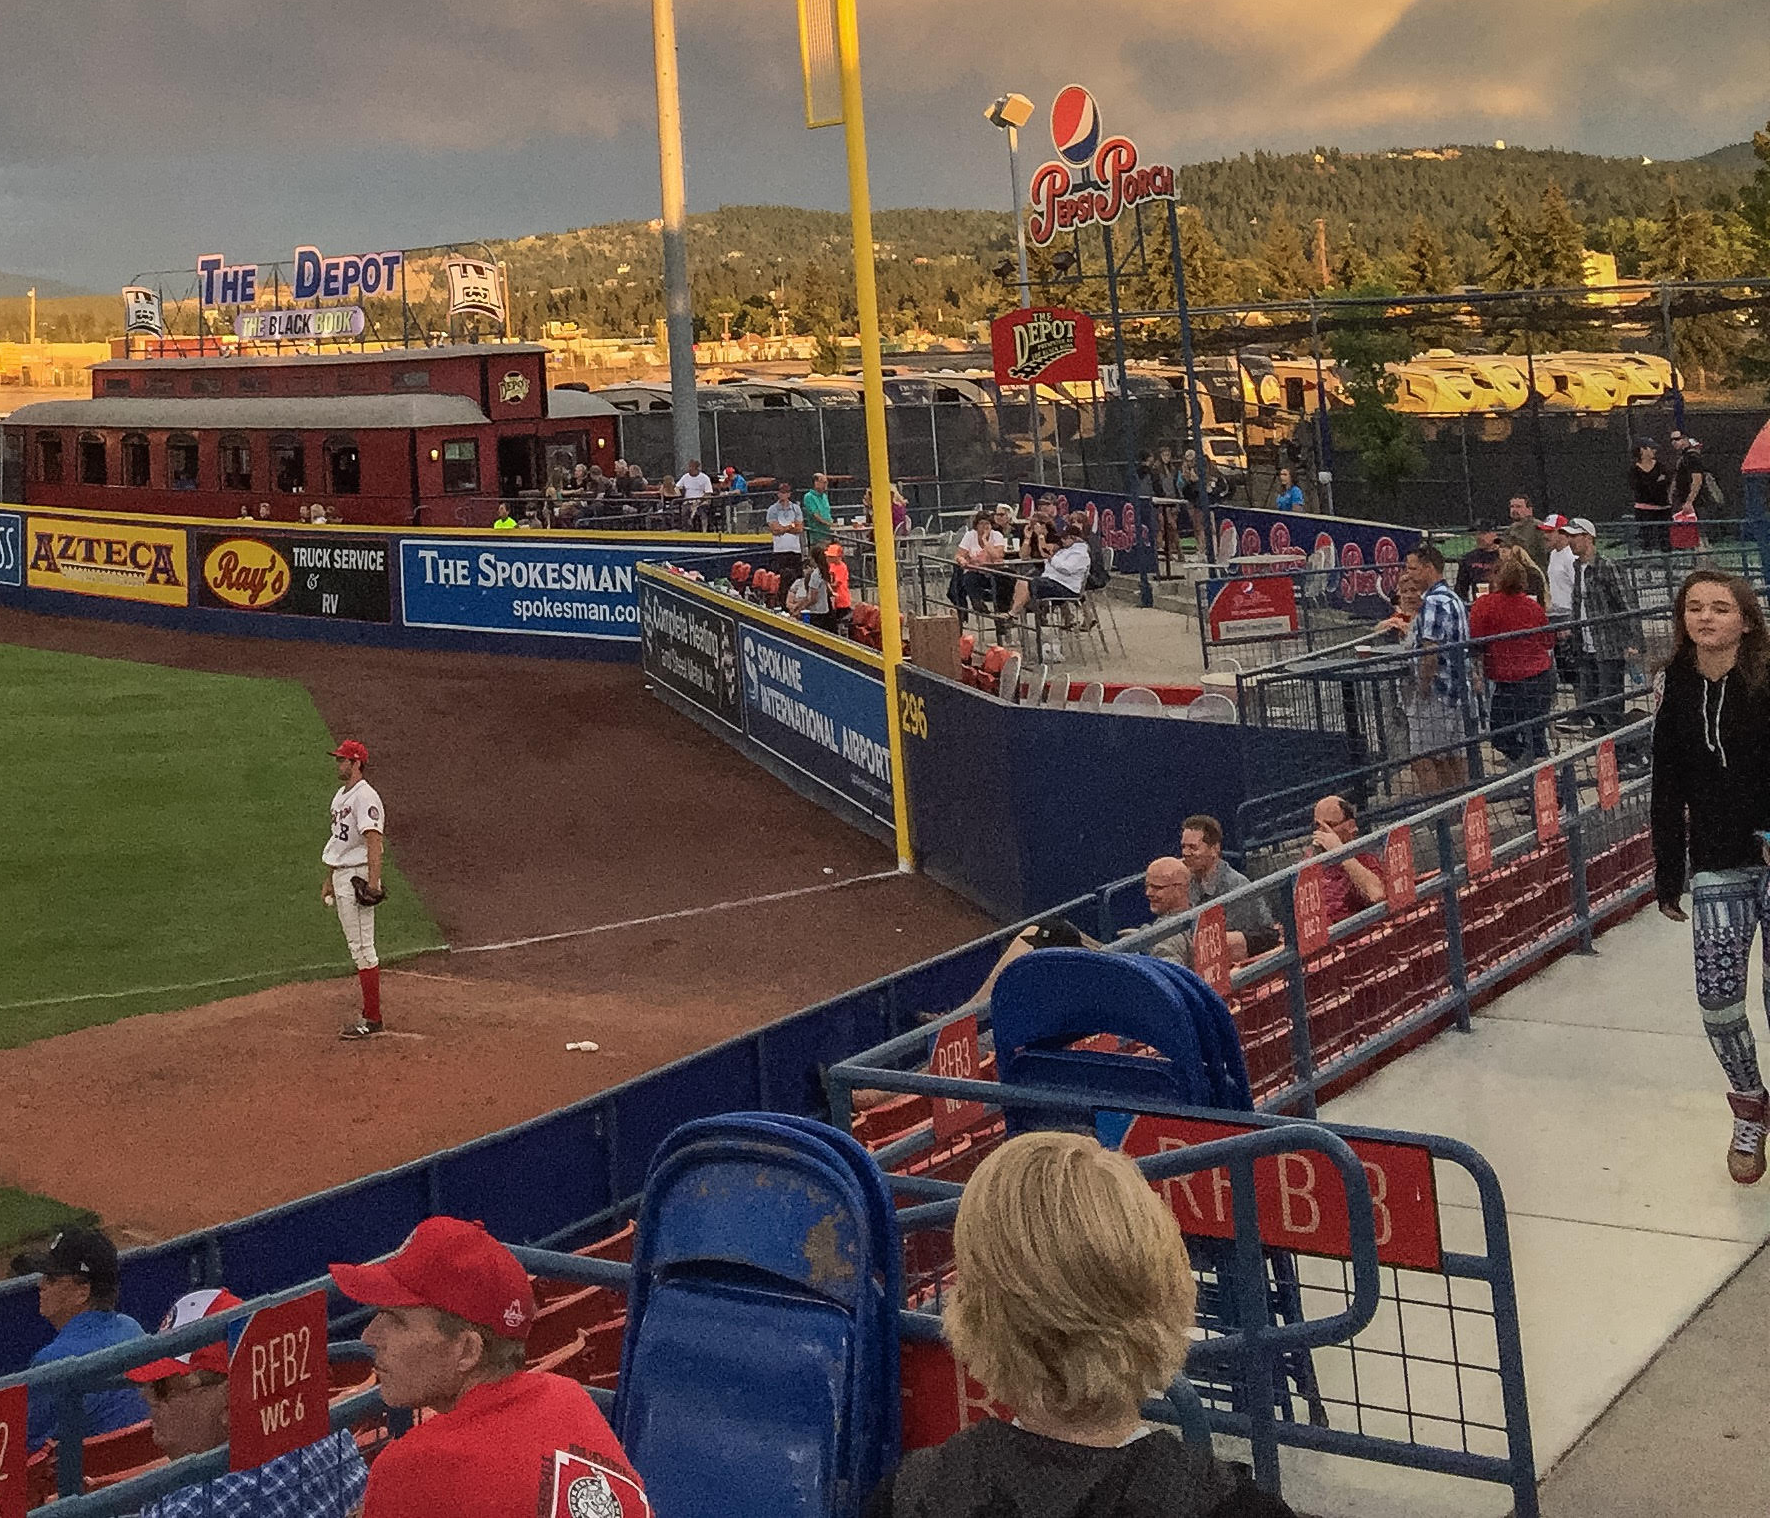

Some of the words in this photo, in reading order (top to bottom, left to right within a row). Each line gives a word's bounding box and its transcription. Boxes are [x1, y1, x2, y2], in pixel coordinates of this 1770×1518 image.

[198, 255, 258, 305] THE
[295, 248, 402, 300] DEPOT
[241, 316, 265, 337] THE
[268, 314, 311, 336] BLACK
[314, 311, 352, 334] BOOK
[1032, 312, 1052, 322] THE
[1013, 319, 1076, 368] DEPOT
[29, 532, 184, 587] AZTECA
[214, 548, 284, 605] Ray's
[292, 546, 331, 569] TRUCK
[333, 548, 385, 571] SERVICE
[306, 573, 320, 590] &
[418, 549, 471, 586] THE
[323, 594, 339, 615] RV
[652, 594, 688, 643] Complete
[756, 642, 804, 694] SPOKANE
[759, 684, 839, 754] INTERNATIONAL
[842, 725, 892, 785] AIRPORT
[900, 690, 928, 740] 296
[935, 1035, 971, 1078] RFB3
[250, 1325, 312, 1400] RFB2
[259, 1401, 293, 1436] WC
[294, 1398, 306, 1427] 6
